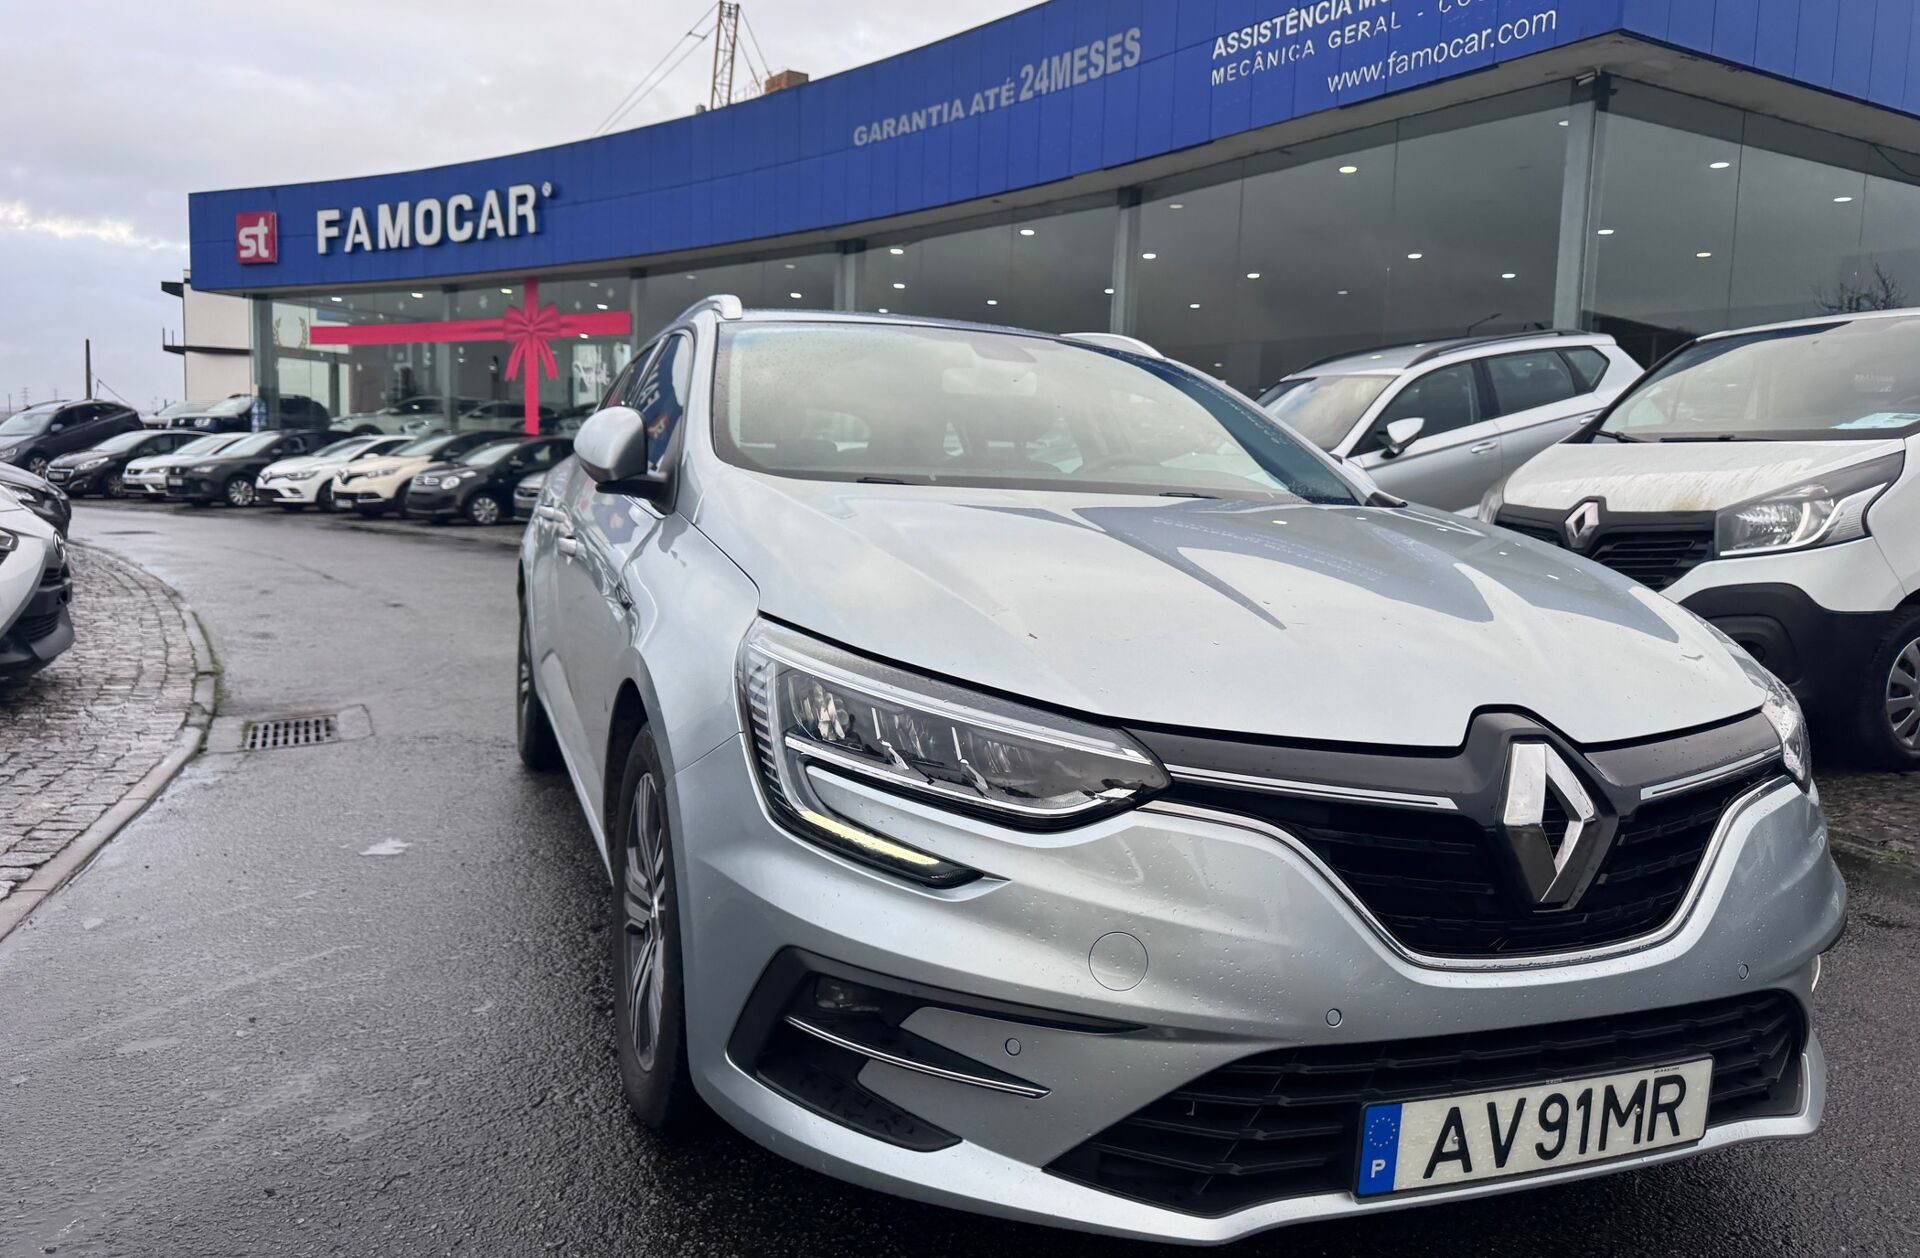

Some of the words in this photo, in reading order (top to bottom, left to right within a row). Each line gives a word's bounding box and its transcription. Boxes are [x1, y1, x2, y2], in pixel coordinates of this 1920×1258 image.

[1211, 39, 1315, 86] MECÂNICA
[1327, 11, 1402, 49] GERAL
[1212, 0, 1352, 60] ASSISTÊNCIA
[1327, 9, 1557, 93] www.famocar.com
[853, 99, 965, 146] GARANTIA
[969, 77, 1016, 116] ATÉ
[1018, 27, 1142, 102] 24MESES
[238, 217, 270, 258] st
[317, 184, 536, 254] FAMOCAR
[1371, 1159, 1386, 1178] P
